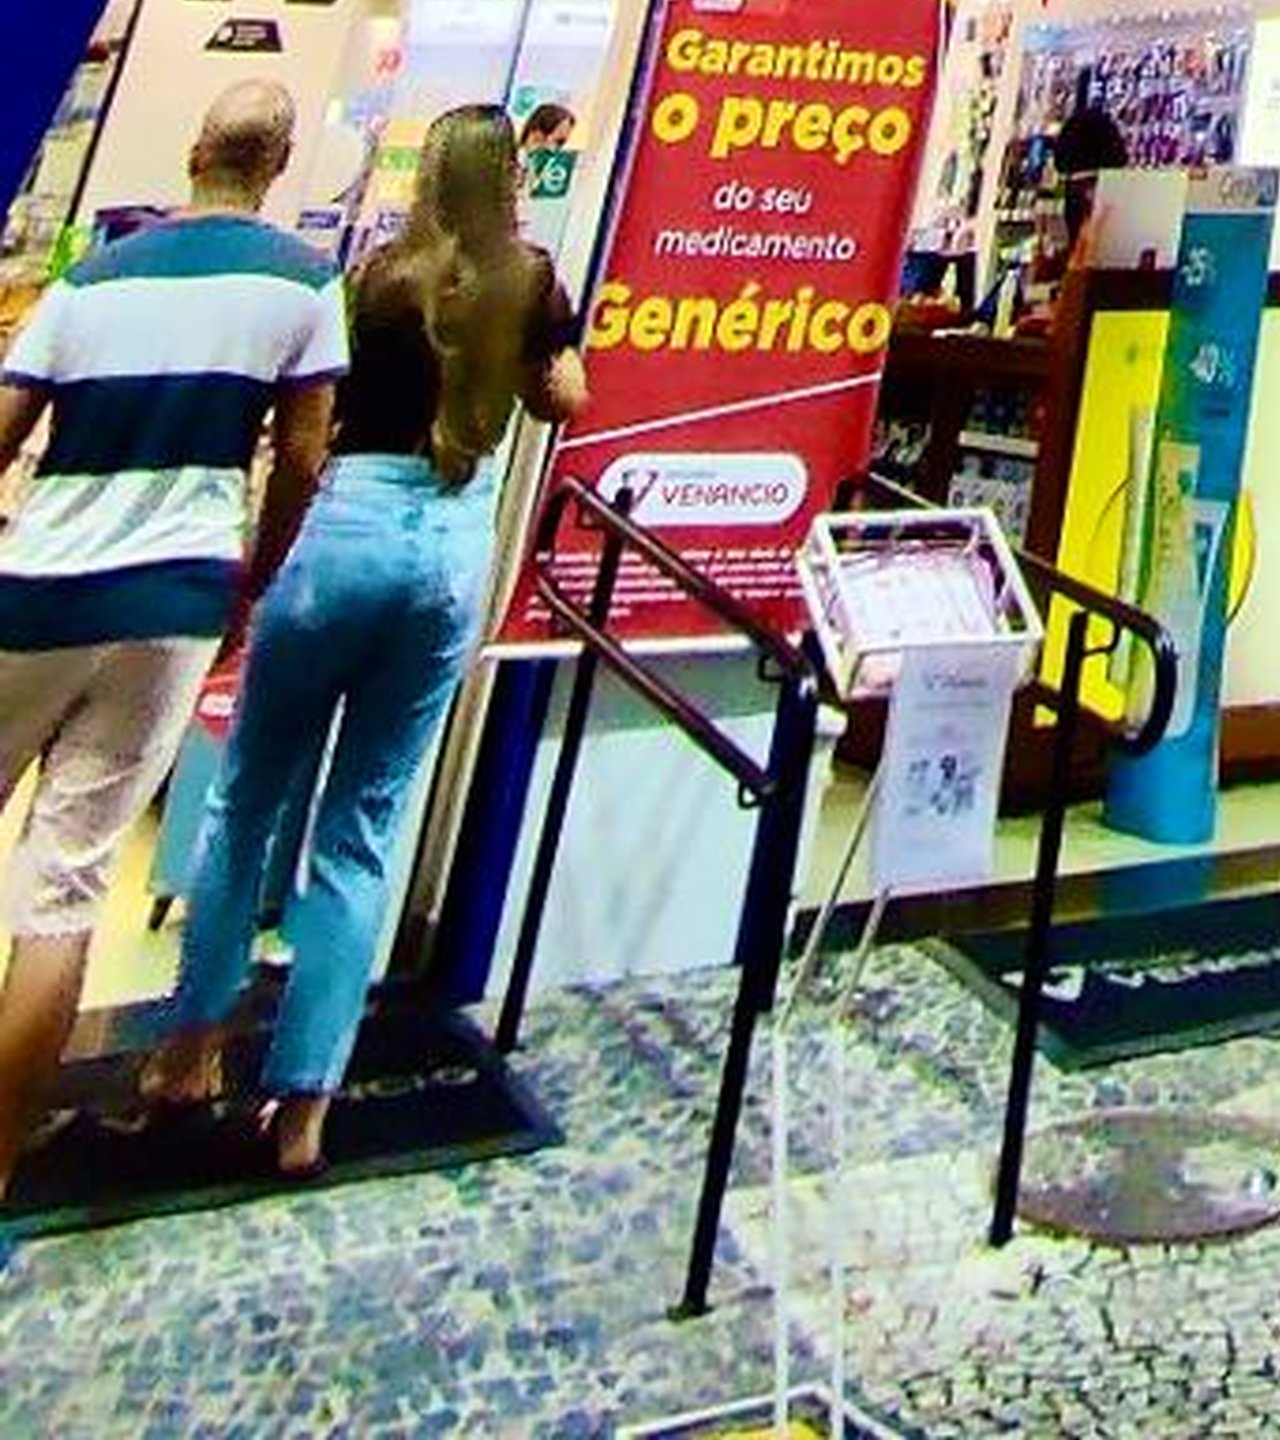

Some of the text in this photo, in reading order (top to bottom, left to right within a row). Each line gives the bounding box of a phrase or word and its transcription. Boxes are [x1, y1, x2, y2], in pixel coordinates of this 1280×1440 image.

[666, 28, 926, 88] Garantimos
[651, 92, 912, 166] o preço
[713, 180, 812, 214] do seu
[655, 225, 857, 262] medicamento
[587, 277, 893, 354] Genérico
[662, 483, 789, 508] VENANCIO
